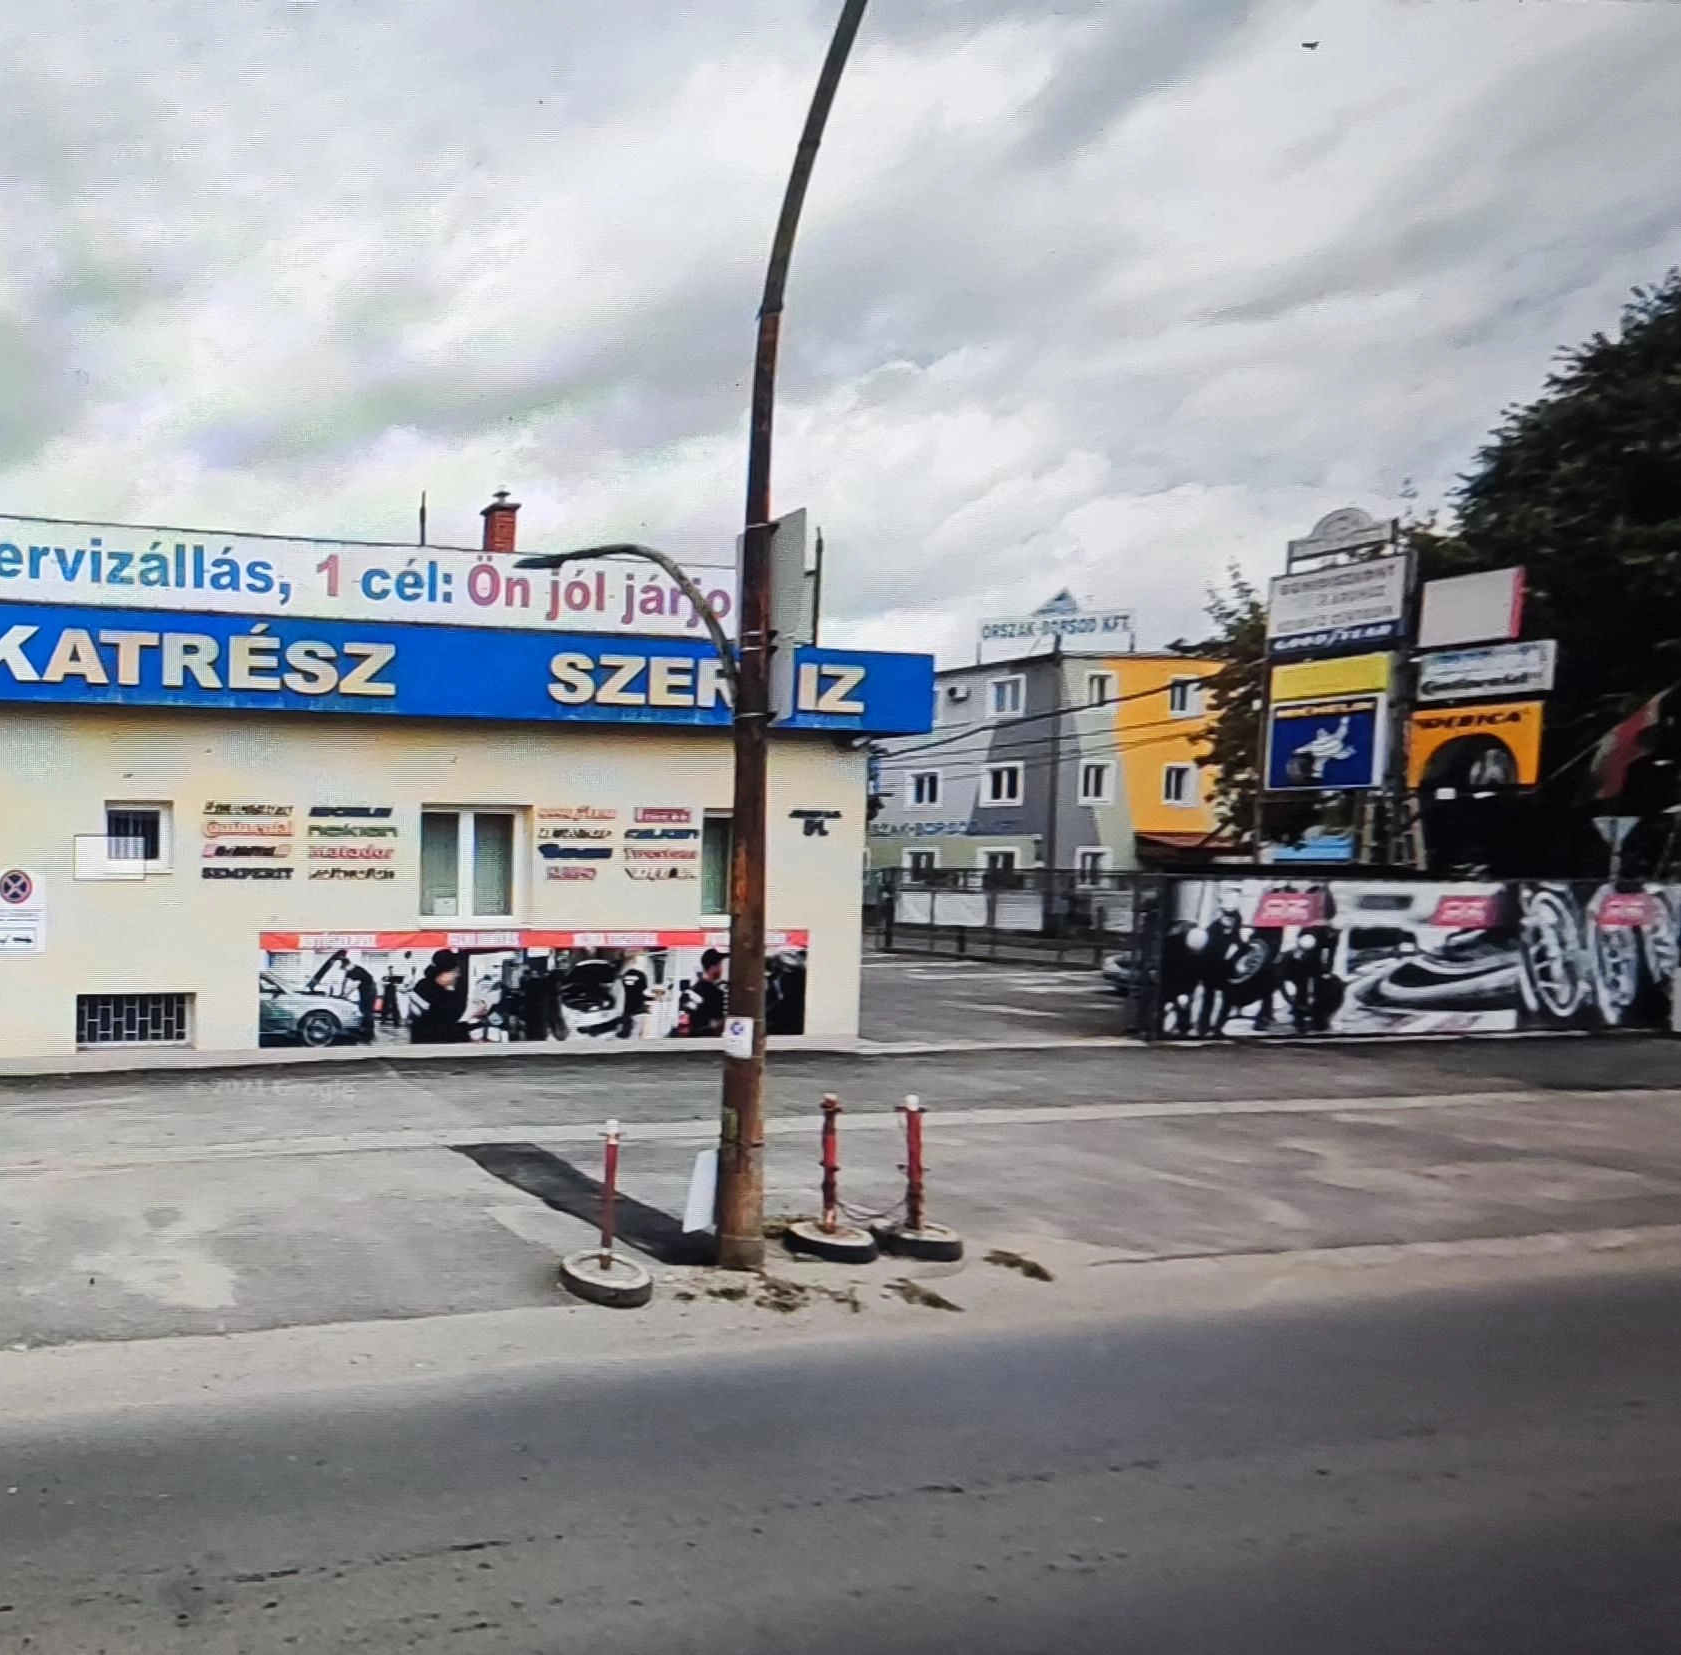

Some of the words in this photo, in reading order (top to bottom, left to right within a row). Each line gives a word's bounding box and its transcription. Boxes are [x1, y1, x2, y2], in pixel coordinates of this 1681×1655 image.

[317, 554, 340, 597] 1
[360, 558, 454, 605] cél:
[467, 555, 531, 606] Ön
[546, 568, 606, 622] jól
[548, 652, 866, 714] SZERIZ
